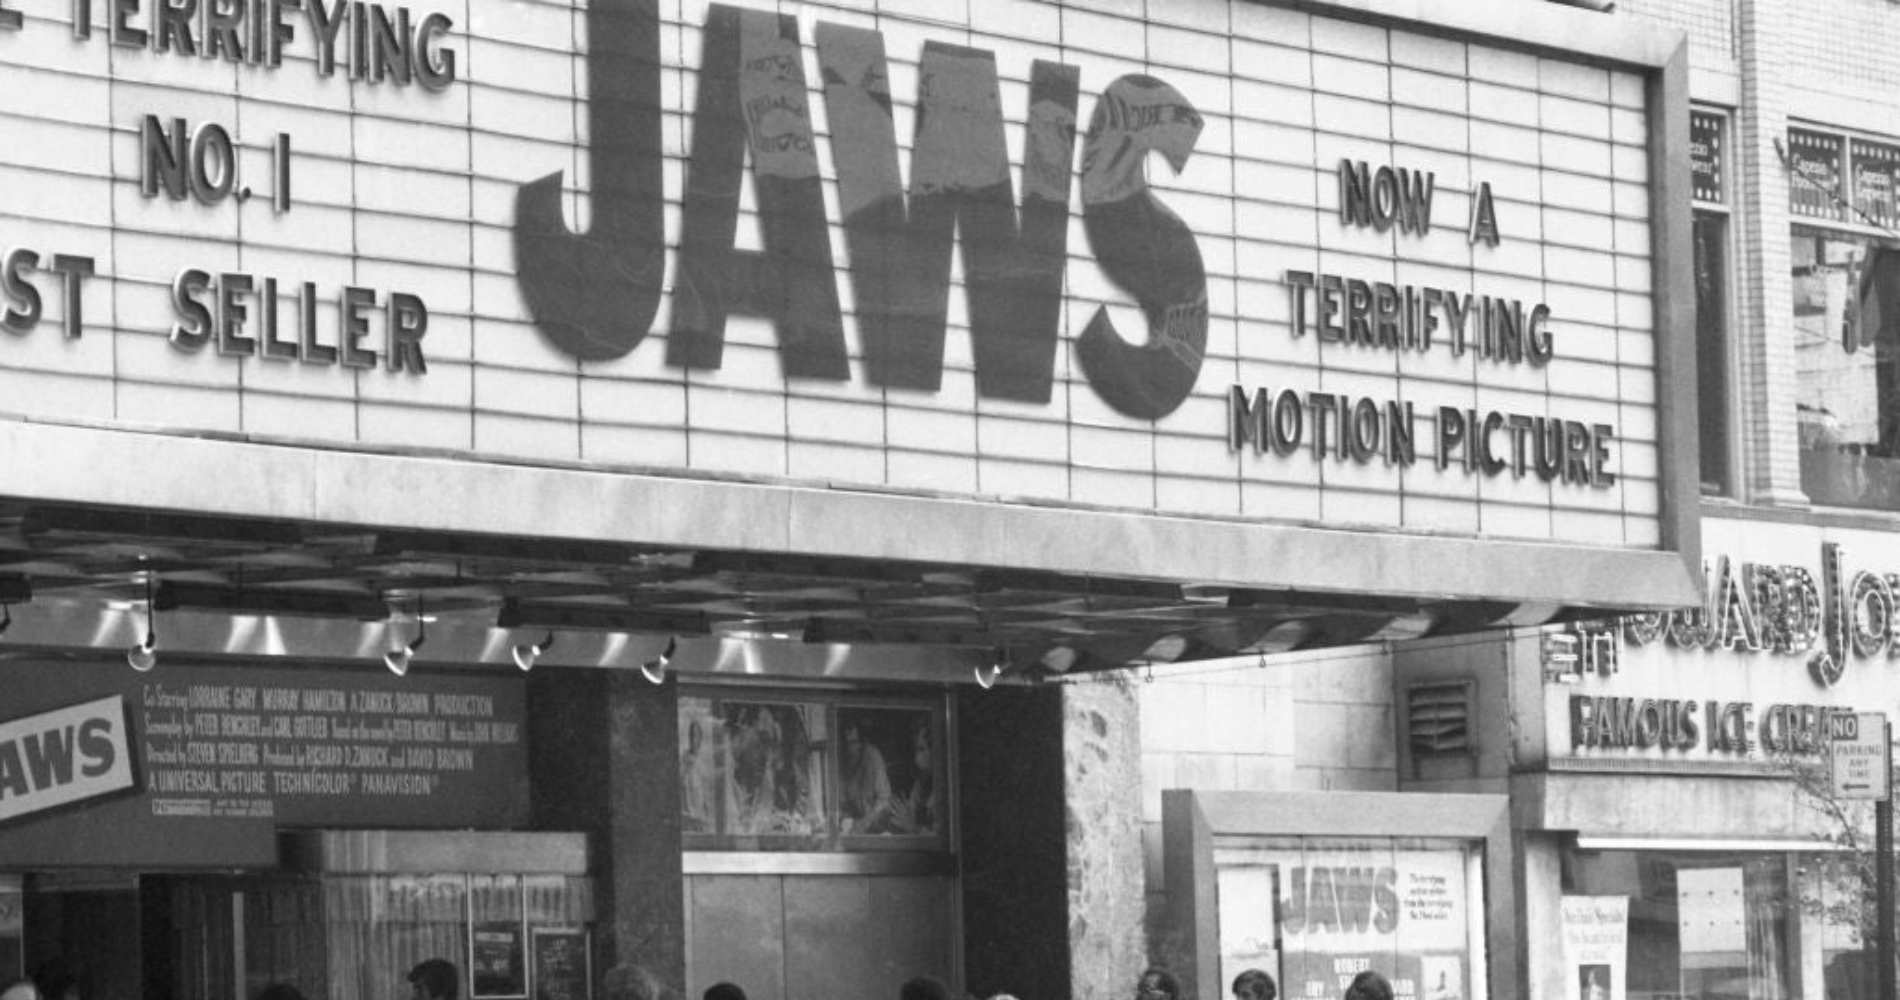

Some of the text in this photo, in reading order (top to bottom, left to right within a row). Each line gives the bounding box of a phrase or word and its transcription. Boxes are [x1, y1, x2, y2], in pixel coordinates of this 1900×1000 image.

[140, 113, 252, 207] NO.
[513, 0, 1209, 421] JAWS
[1339, 158, 1501, 248] NOW A
[0, 248, 428, 376] ST SELLER
[1282, 268, 1554, 369] TERRIFYING
[1226, 384, 1616, 490] MOTION PICTURE
[434, 693, 493, 717] PRODUCTION
[1570, 695, 1699, 753] FAMOUS
[1705, 700, 1755, 755] ICE
[1832, 717, 1857, 738] NO
[0, 717, 116, 801] AWS
[148, 770, 157, 792] A
[159, 769, 219, 793] UNIVERSAL
[220, 770, 266, 793] PICTURE
[1836, 744, 1882, 757] PARKING
[1847, 769, 1871, 779] TIME
[1849, 758, 1869, 768] ANY
[1281, 866, 1400, 935] JAWS
